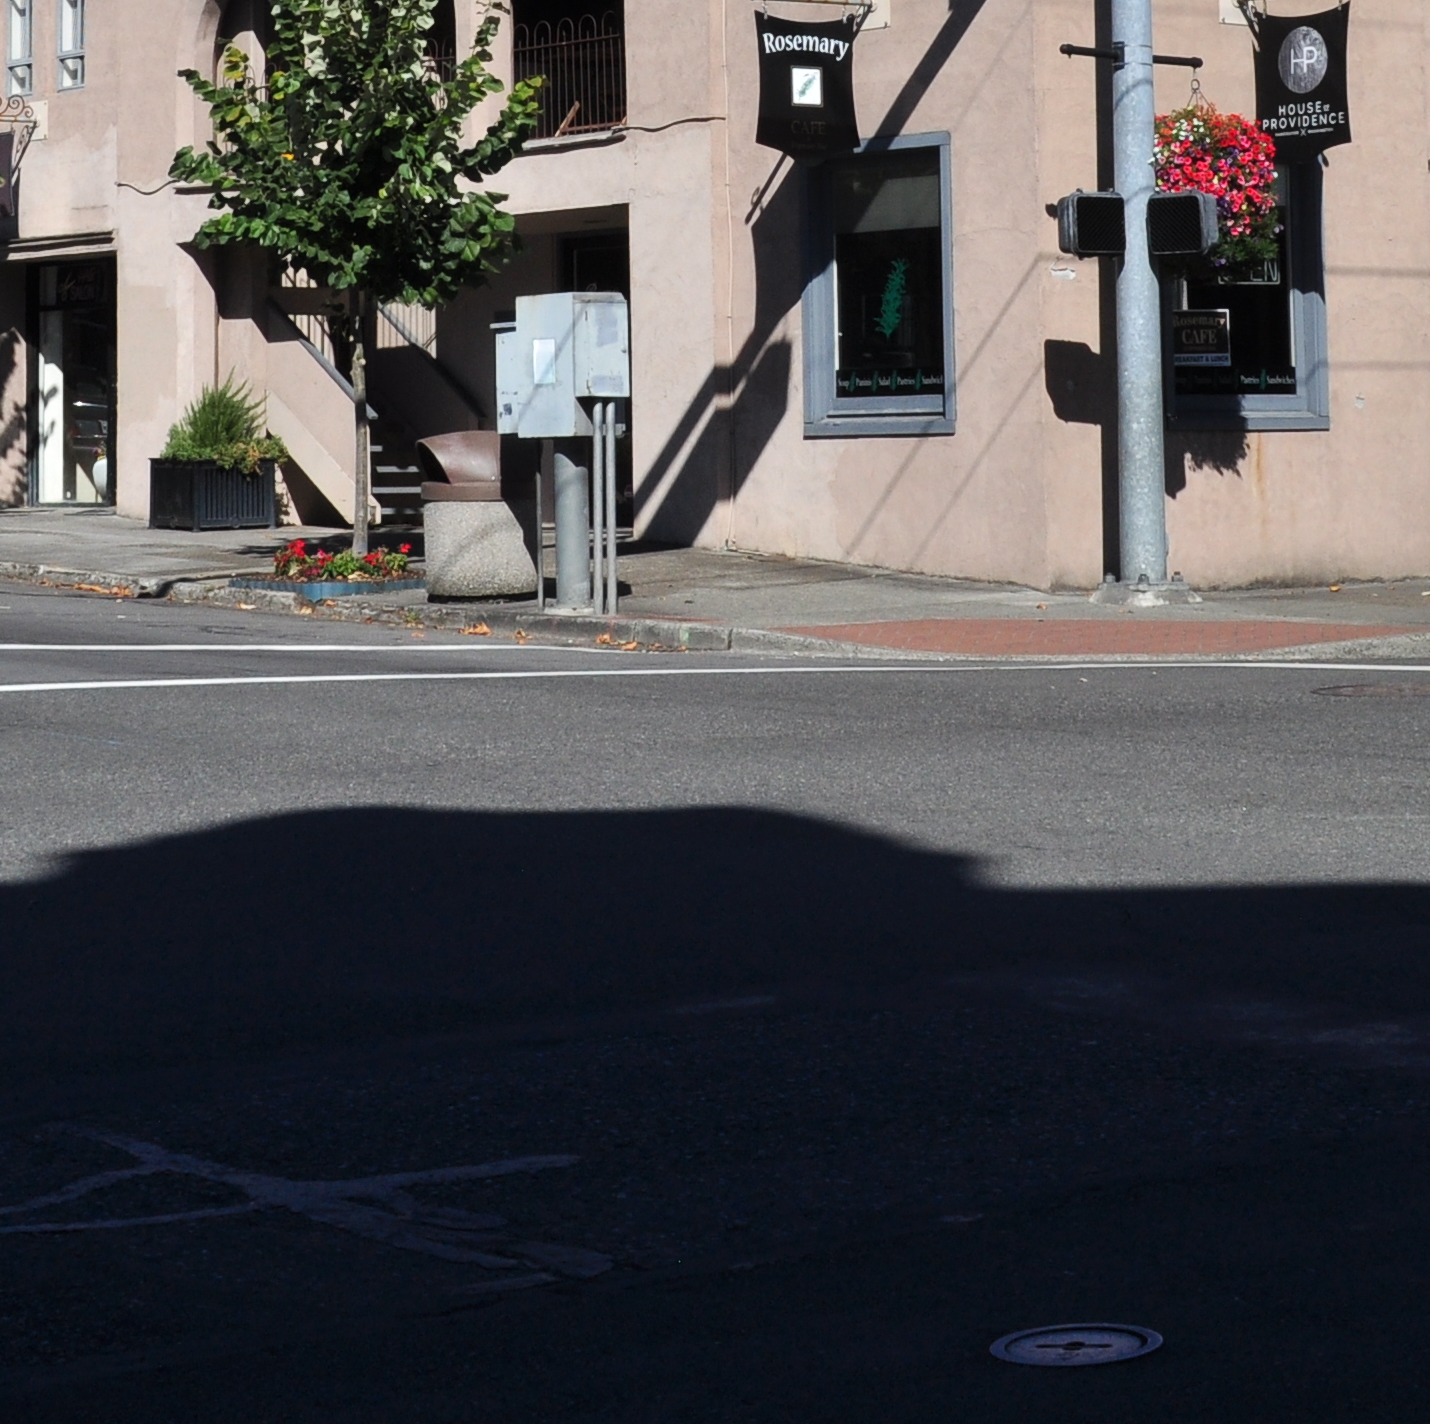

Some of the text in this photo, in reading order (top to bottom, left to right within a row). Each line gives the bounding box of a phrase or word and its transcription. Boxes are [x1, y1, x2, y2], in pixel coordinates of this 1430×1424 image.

[762, 32, 850, 61] Rosemary
[1278, 101, 1322, 116] HOUSE
[1262, 112, 1345, 131] PROVIDENCE
[1181, 329, 1217, 344] CAFE
